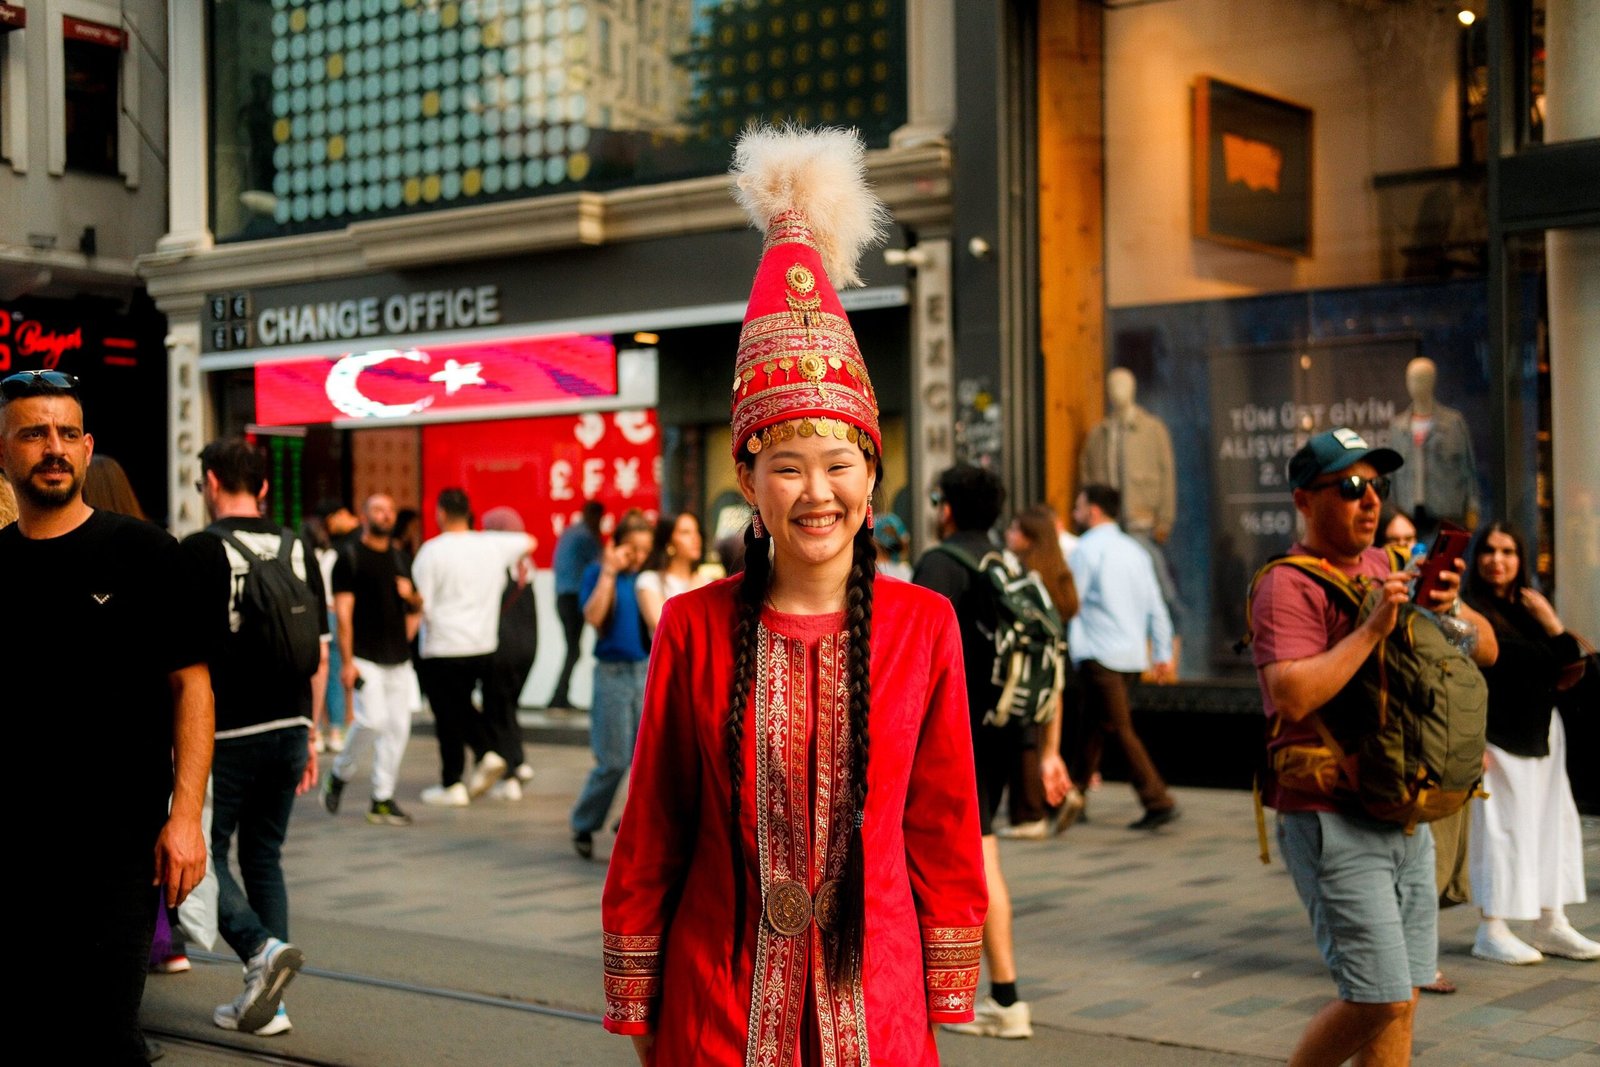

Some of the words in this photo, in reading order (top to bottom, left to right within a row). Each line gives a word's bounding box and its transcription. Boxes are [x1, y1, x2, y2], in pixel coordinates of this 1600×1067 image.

[257, 297, 380, 346] CHANGE
[384, 285, 500, 334] OFFICE
[178, 363, 192, 521] EXCHA
